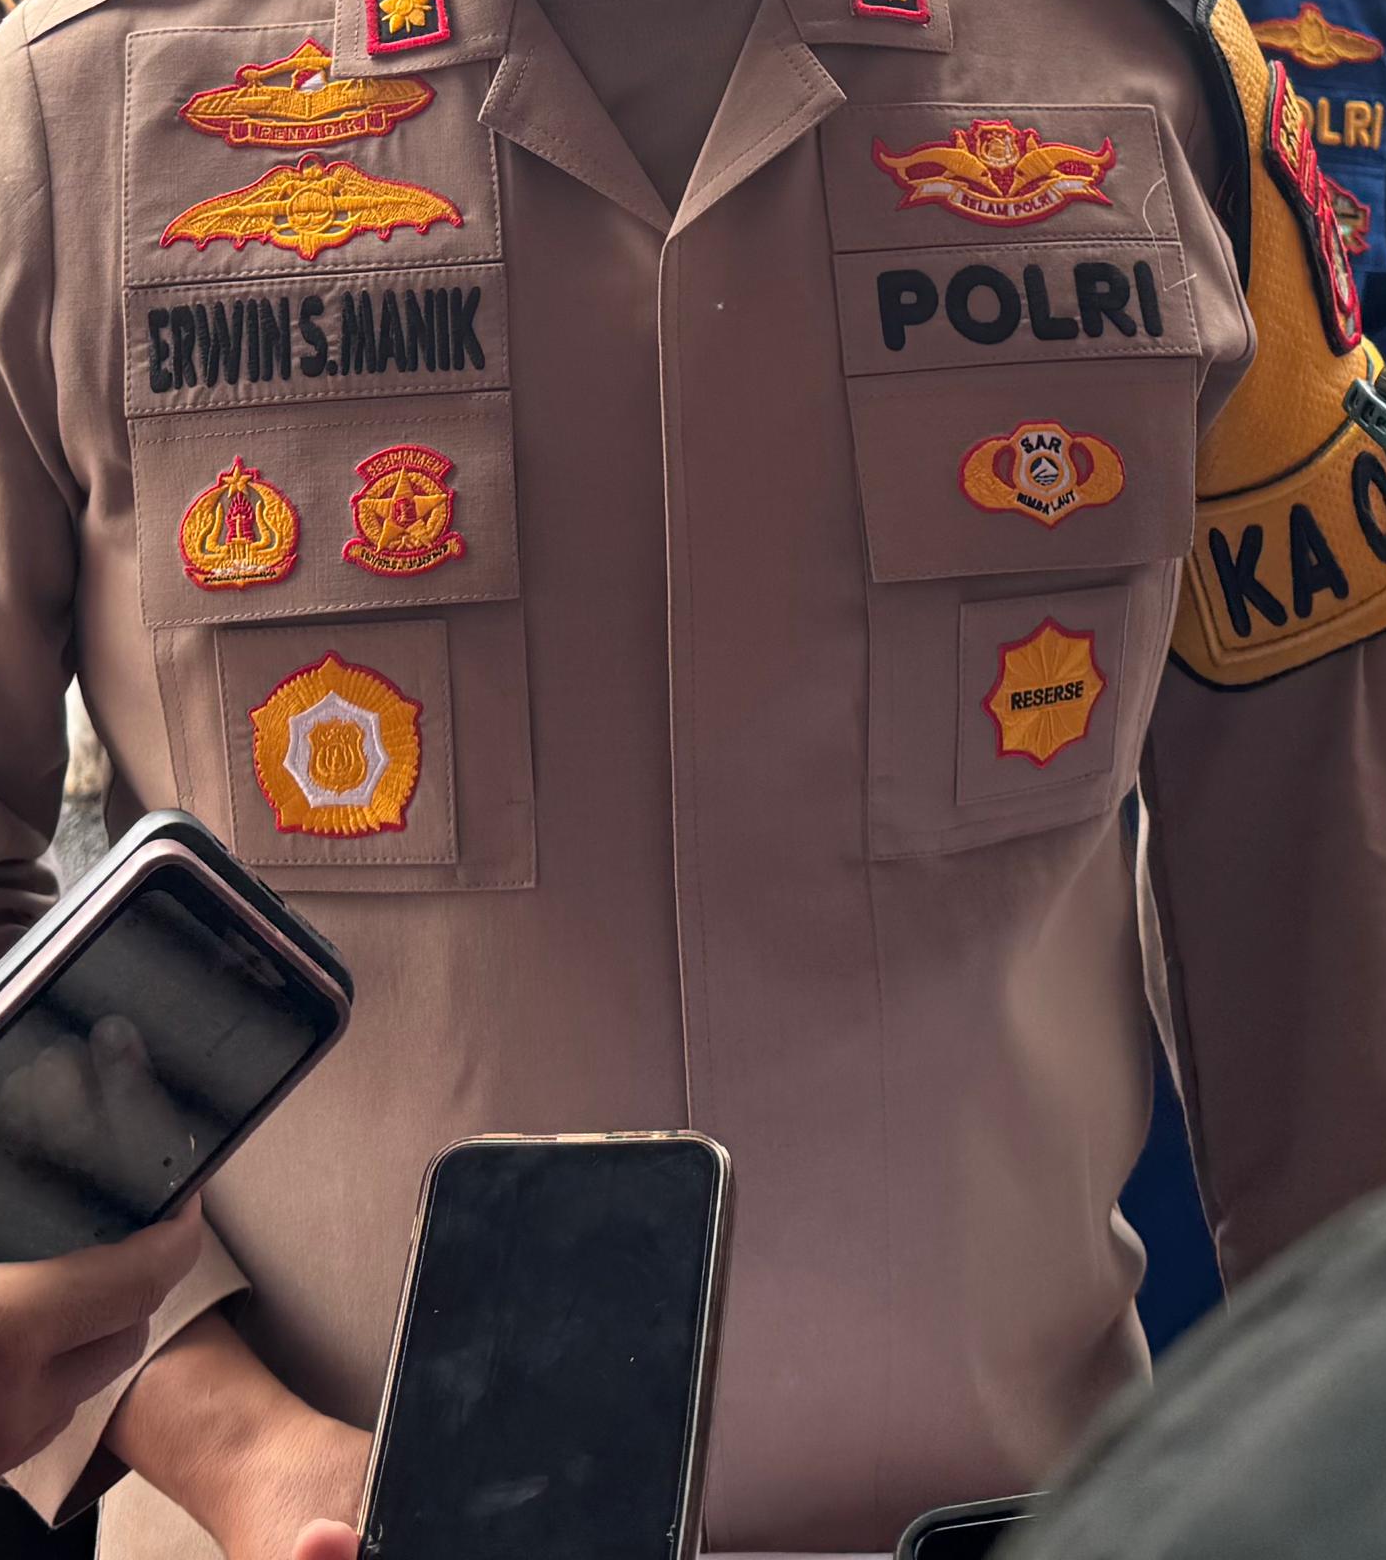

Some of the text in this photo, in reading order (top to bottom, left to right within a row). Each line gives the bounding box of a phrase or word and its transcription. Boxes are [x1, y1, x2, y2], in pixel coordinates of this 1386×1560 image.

[961, 194, 1054, 217] SELAM POLRI
[876, 259, 1165, 351] POLRI
[148, 295, 292, 393] ERWIN
[1020, 435, 1062, 454] SAR
[1051, 490, 1076, 512] LAUT
[1209, 503, 1349, 638] KA
[1010, 680, 1084, 711] RESERSE
